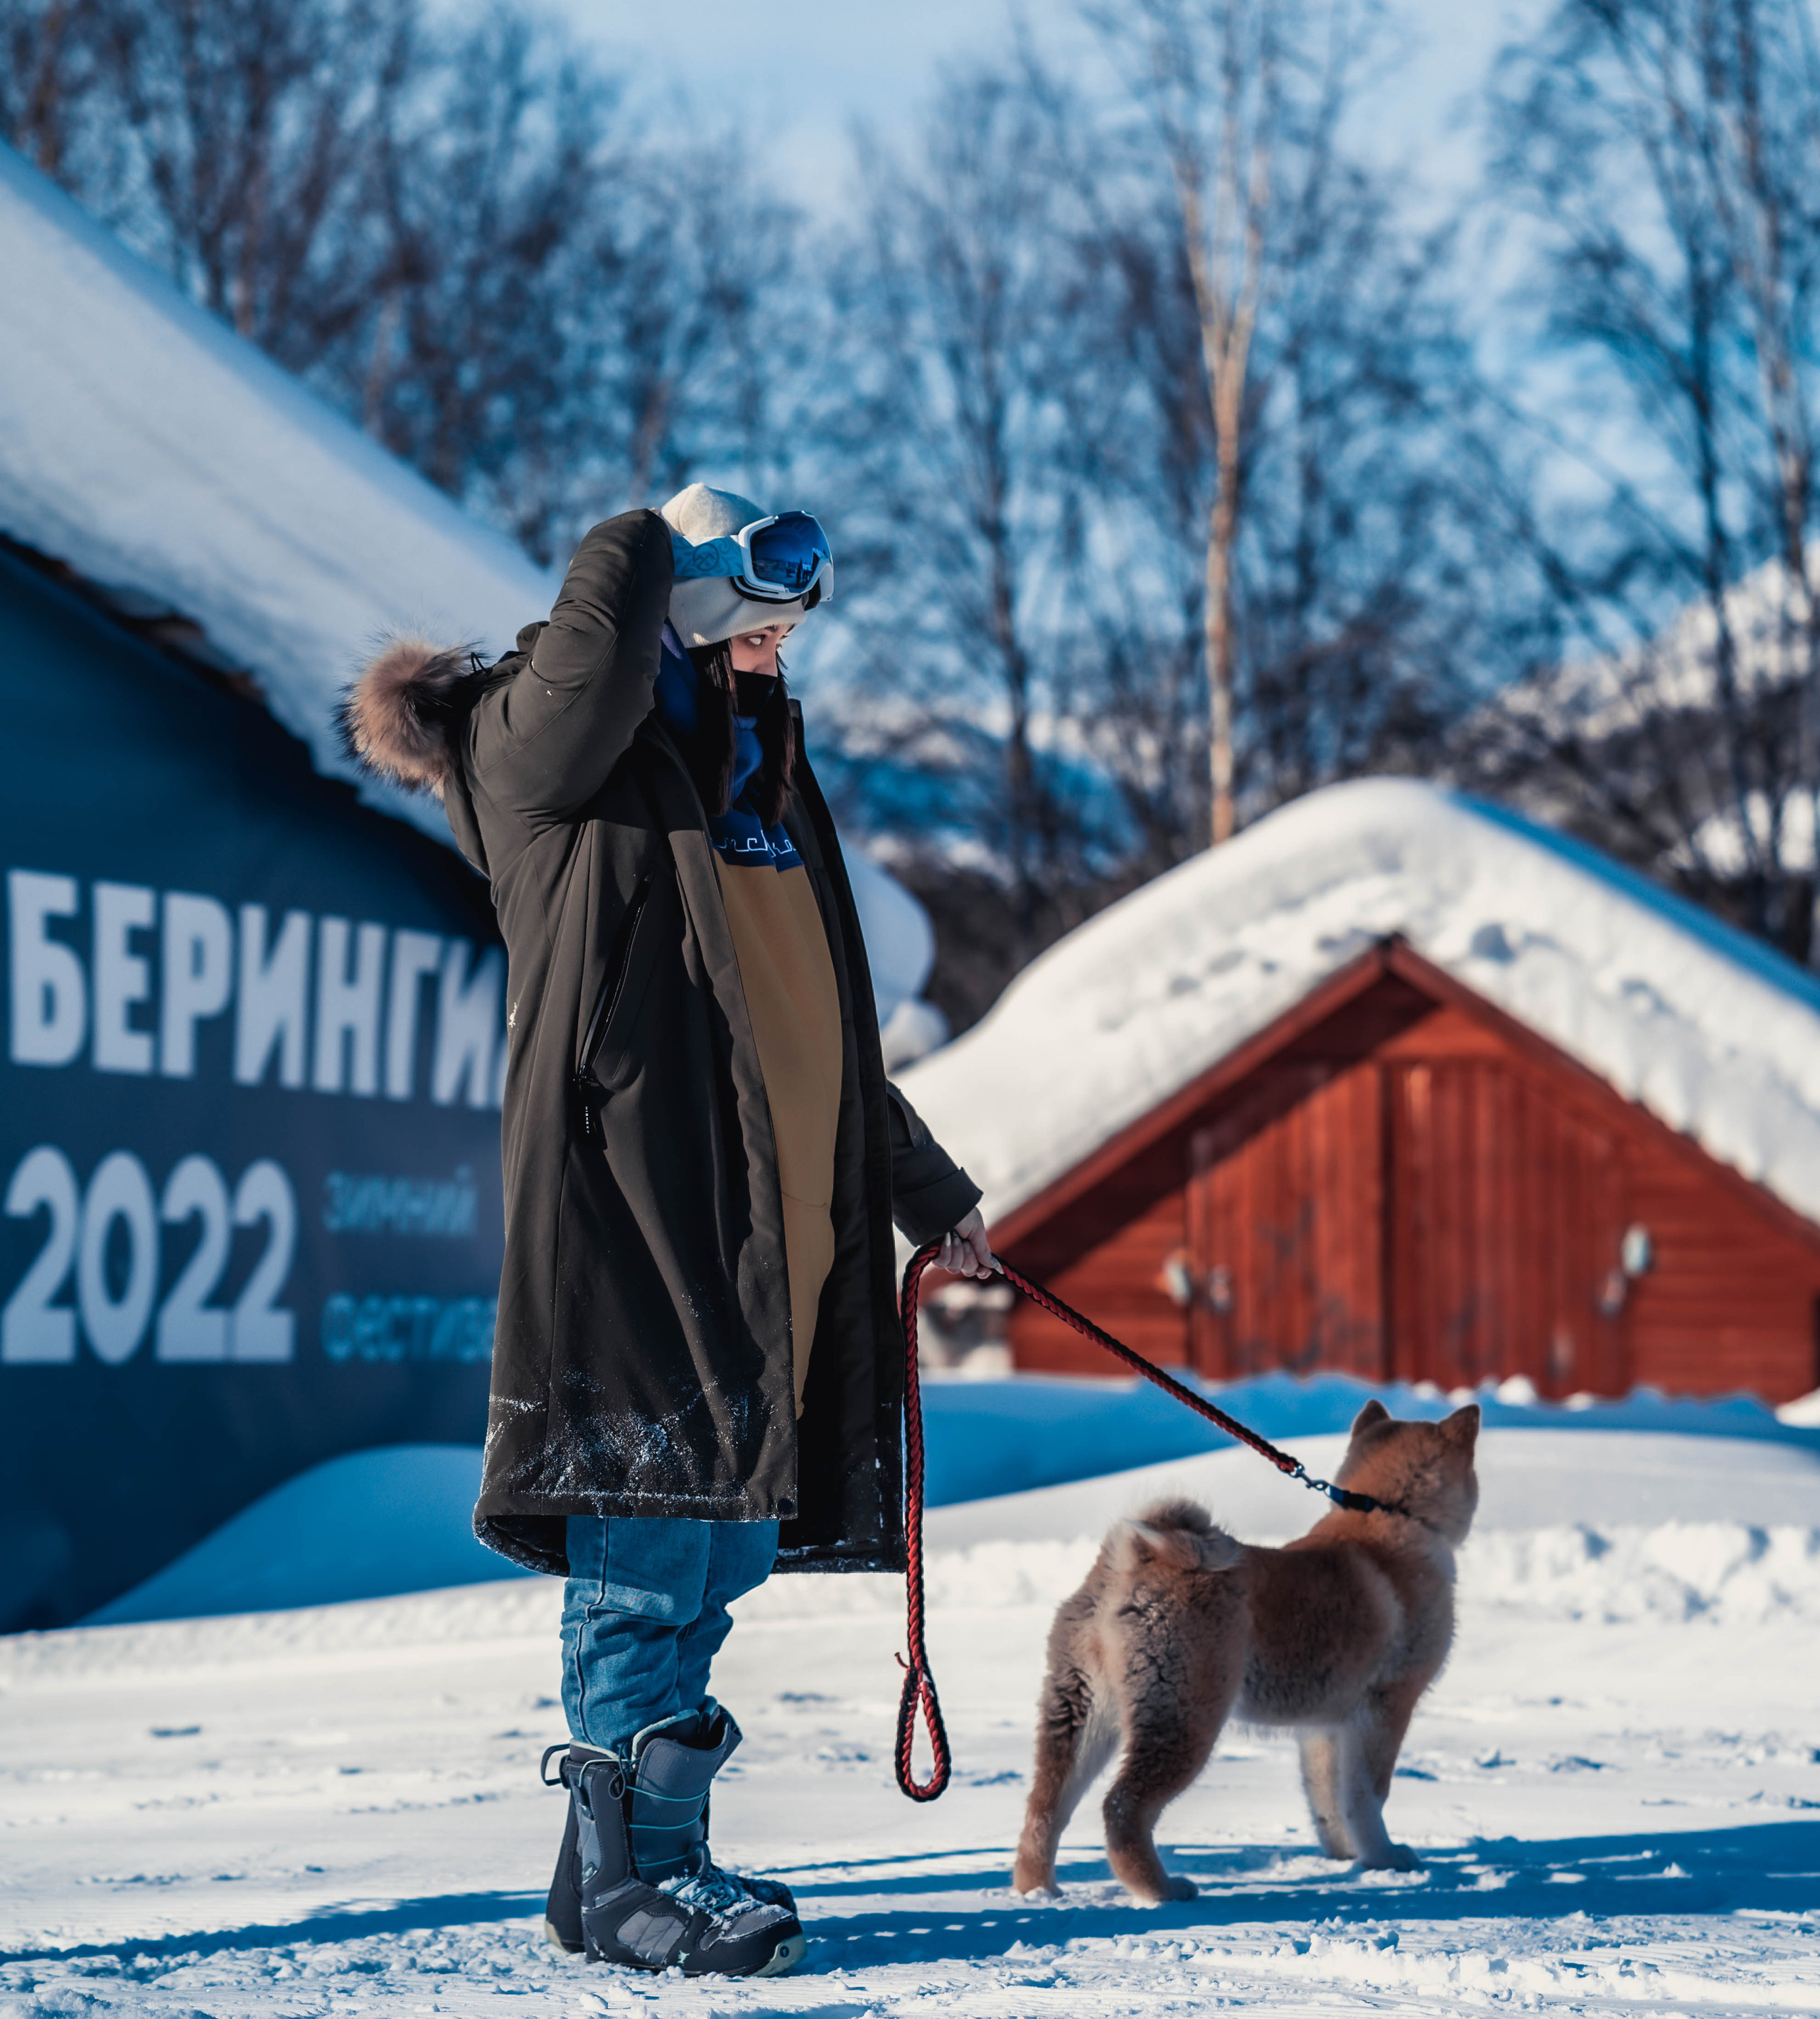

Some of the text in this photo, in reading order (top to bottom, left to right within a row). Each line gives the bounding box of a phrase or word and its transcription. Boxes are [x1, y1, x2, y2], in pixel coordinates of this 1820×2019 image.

[7, 869, 506, 1110] БЕРИНГИ
[1, 1145, 297, 1364] 2022
[322, 1164, 478, 1238] ЗИМНИЙ
[321, 1291, 499, 1364] ФЕСТИВ
